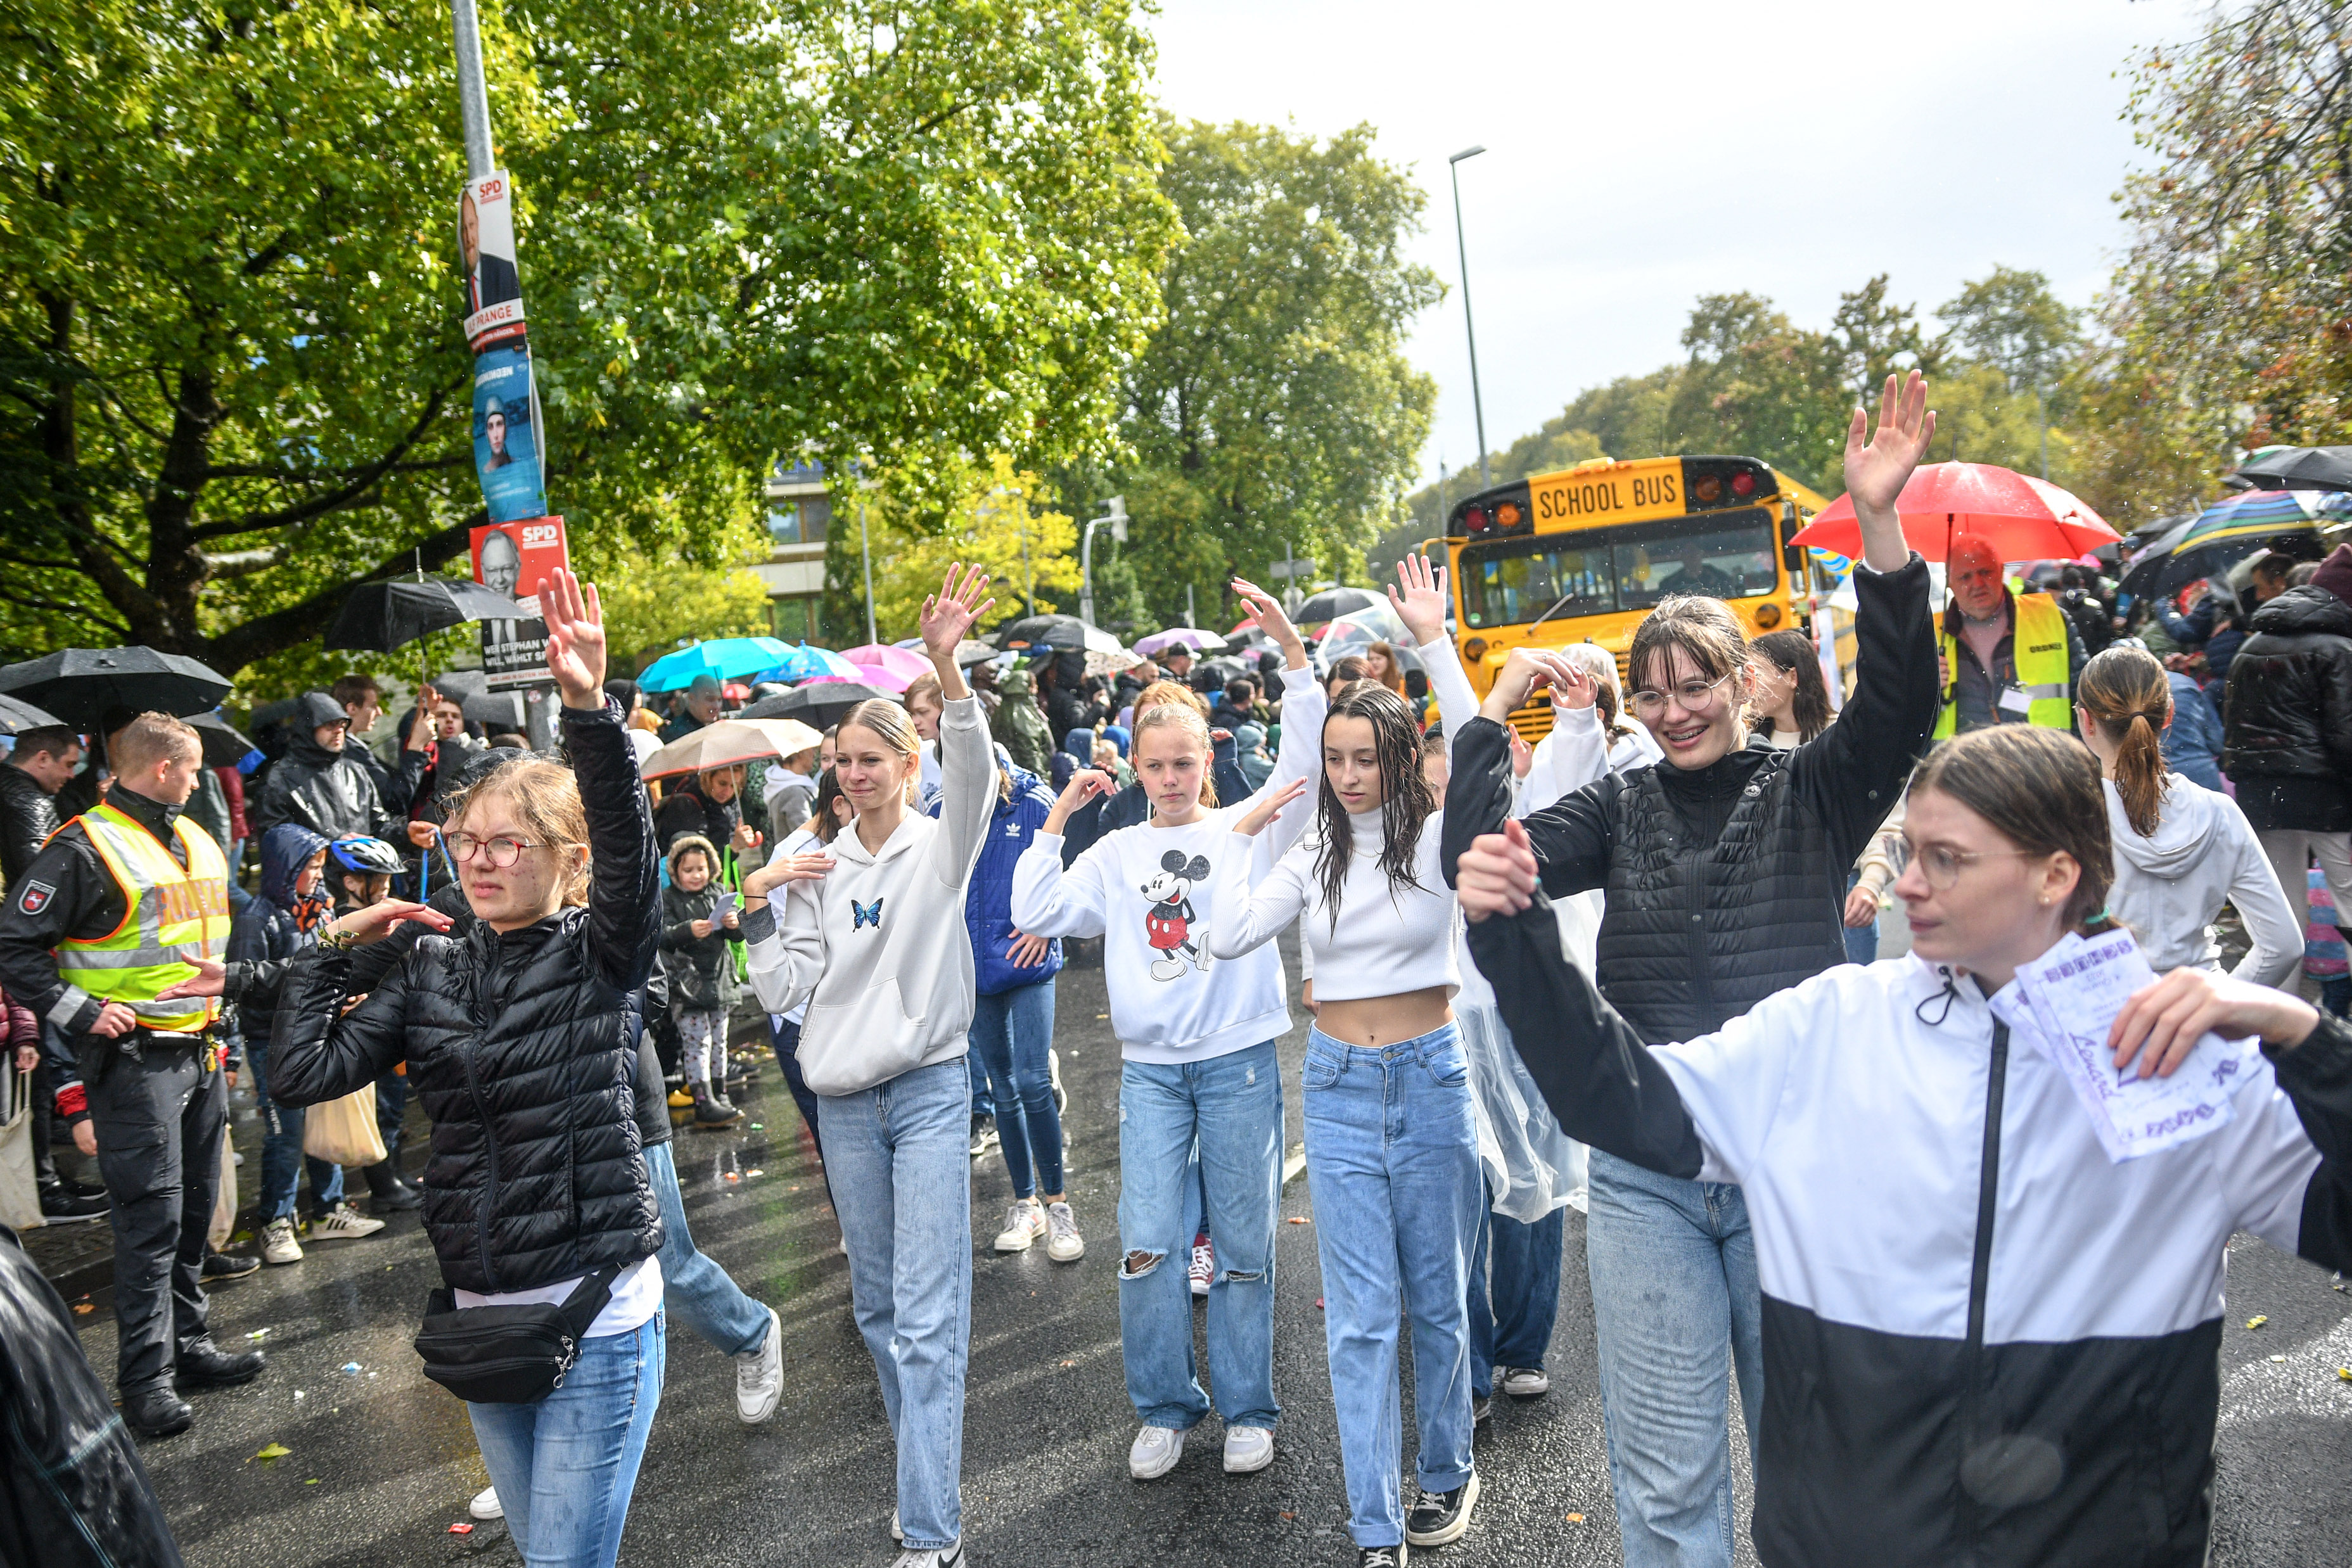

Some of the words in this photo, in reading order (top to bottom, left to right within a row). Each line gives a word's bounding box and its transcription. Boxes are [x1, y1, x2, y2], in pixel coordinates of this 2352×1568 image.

[480, 180, 501, 198] SPD
[476, 305, 512, 328] PRANGE
[1540, 482, 1623, 519] SCHOOL
[1634, 474, 1676, 506] BUS
[522, 525, 558, 542] SPD
[483, 644, 500, 655] WER
[501, 639, 540, 654] STEPHAN
[485, 656, 505, 667] WILL,
[504, 652, 533, 665] WÄHLT
[534, 651, 546, 661] SP
